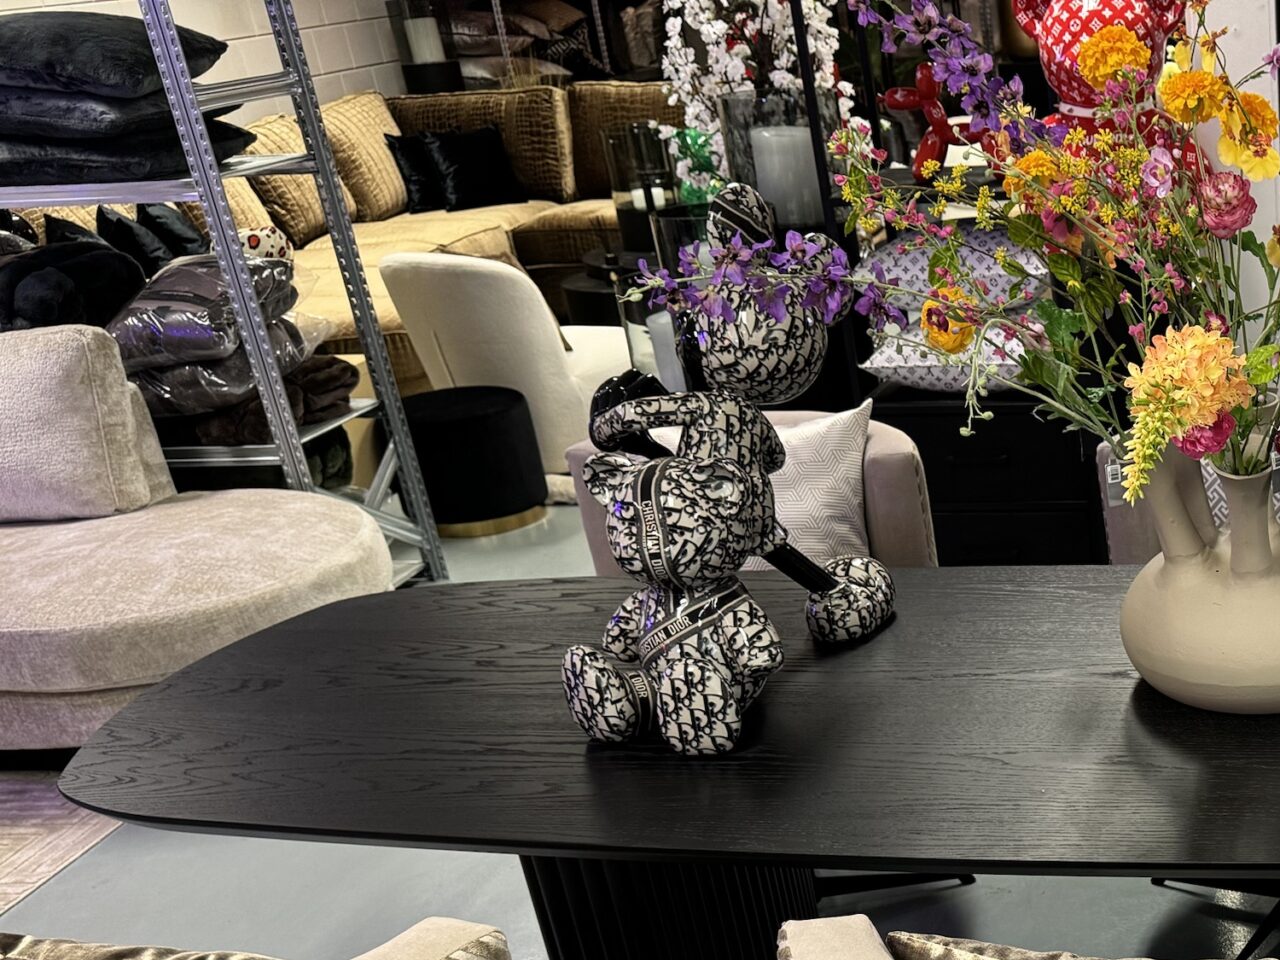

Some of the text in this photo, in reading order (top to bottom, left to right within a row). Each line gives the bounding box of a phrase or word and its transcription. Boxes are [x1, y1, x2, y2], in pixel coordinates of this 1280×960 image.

[641, 500, 661, 554] CHRISTIAN
[667, 616, 693, 635] DIOR
[632, 676, 648, 698] DIOR
